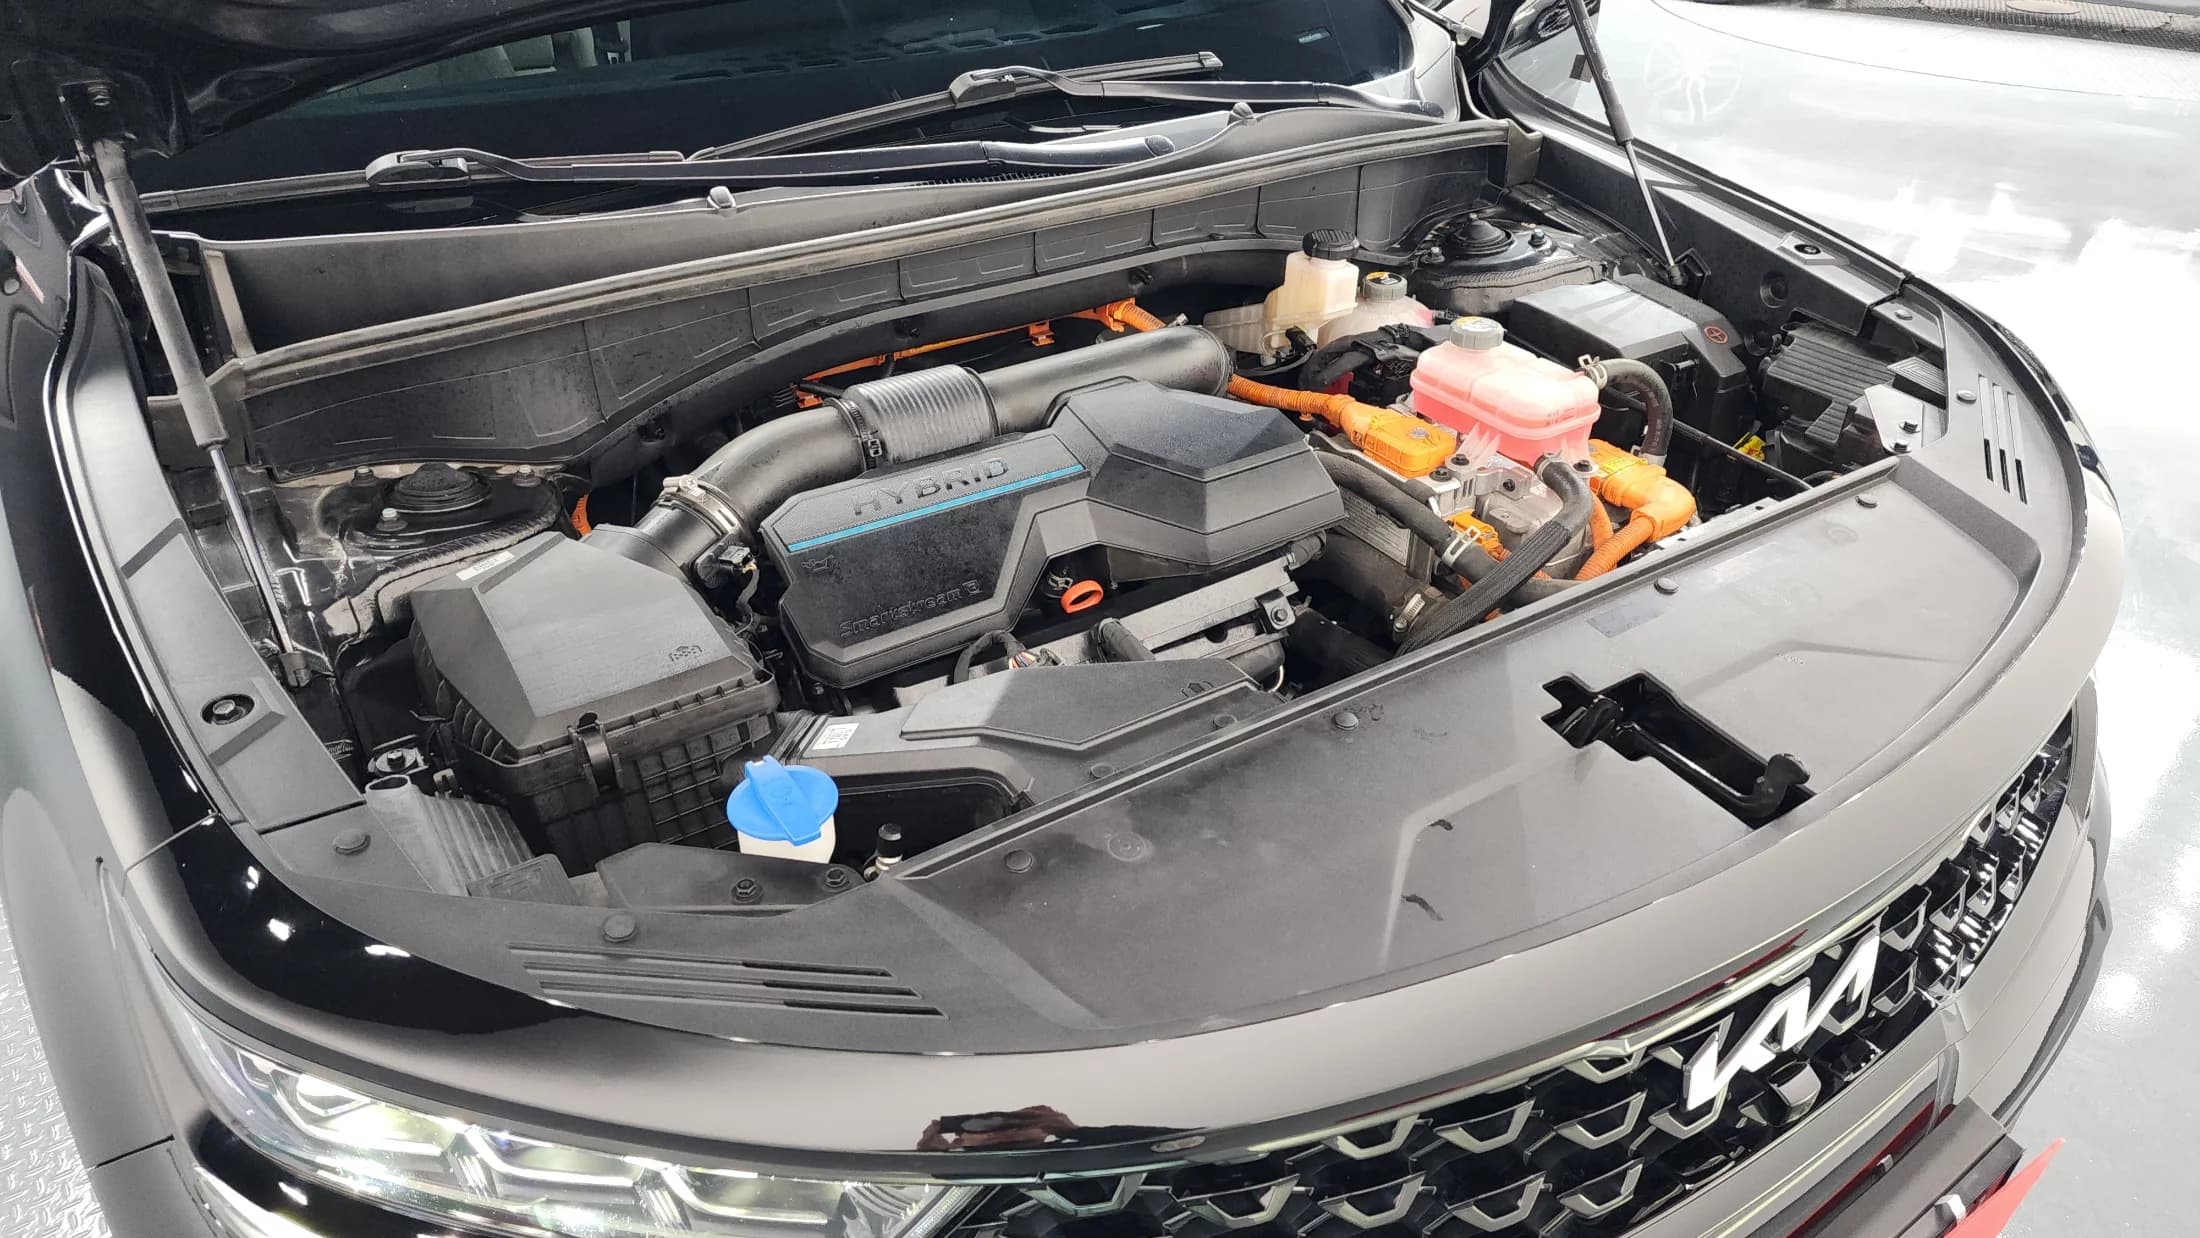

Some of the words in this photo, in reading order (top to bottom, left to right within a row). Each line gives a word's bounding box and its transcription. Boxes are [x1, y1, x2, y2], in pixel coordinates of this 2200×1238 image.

[850, 457, 1009, 516] HYBRID
[839, 588, 963, 638] Smartstream
[1684, 929, 1880, 1111] KIA
